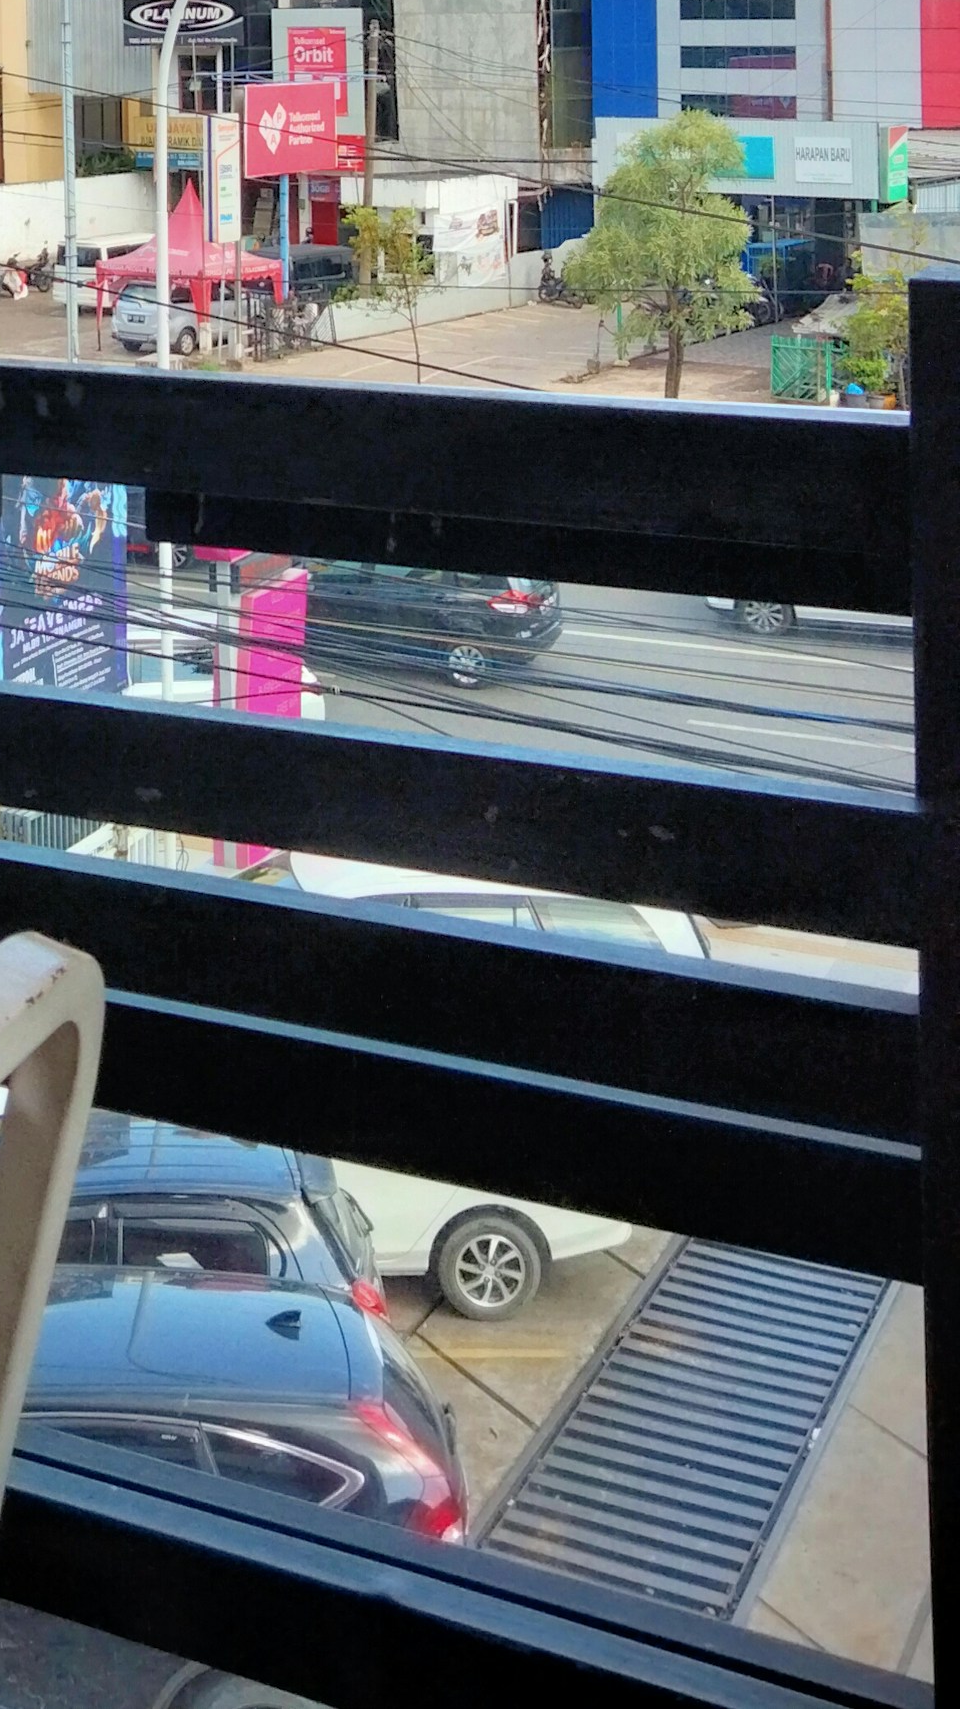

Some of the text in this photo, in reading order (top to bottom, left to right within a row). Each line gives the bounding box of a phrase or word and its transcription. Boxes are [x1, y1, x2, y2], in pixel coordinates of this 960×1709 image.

[143, 7, 220, 21] PLANUM
[294, 46, 334, 63] Orbit
[288, 110, 321, 122] Telkomsel
[288, 121, 325, 133] Authorized
[288, 134, 313, 146] Partner
[795, 147, 851, 162] HARAPAN BARU
